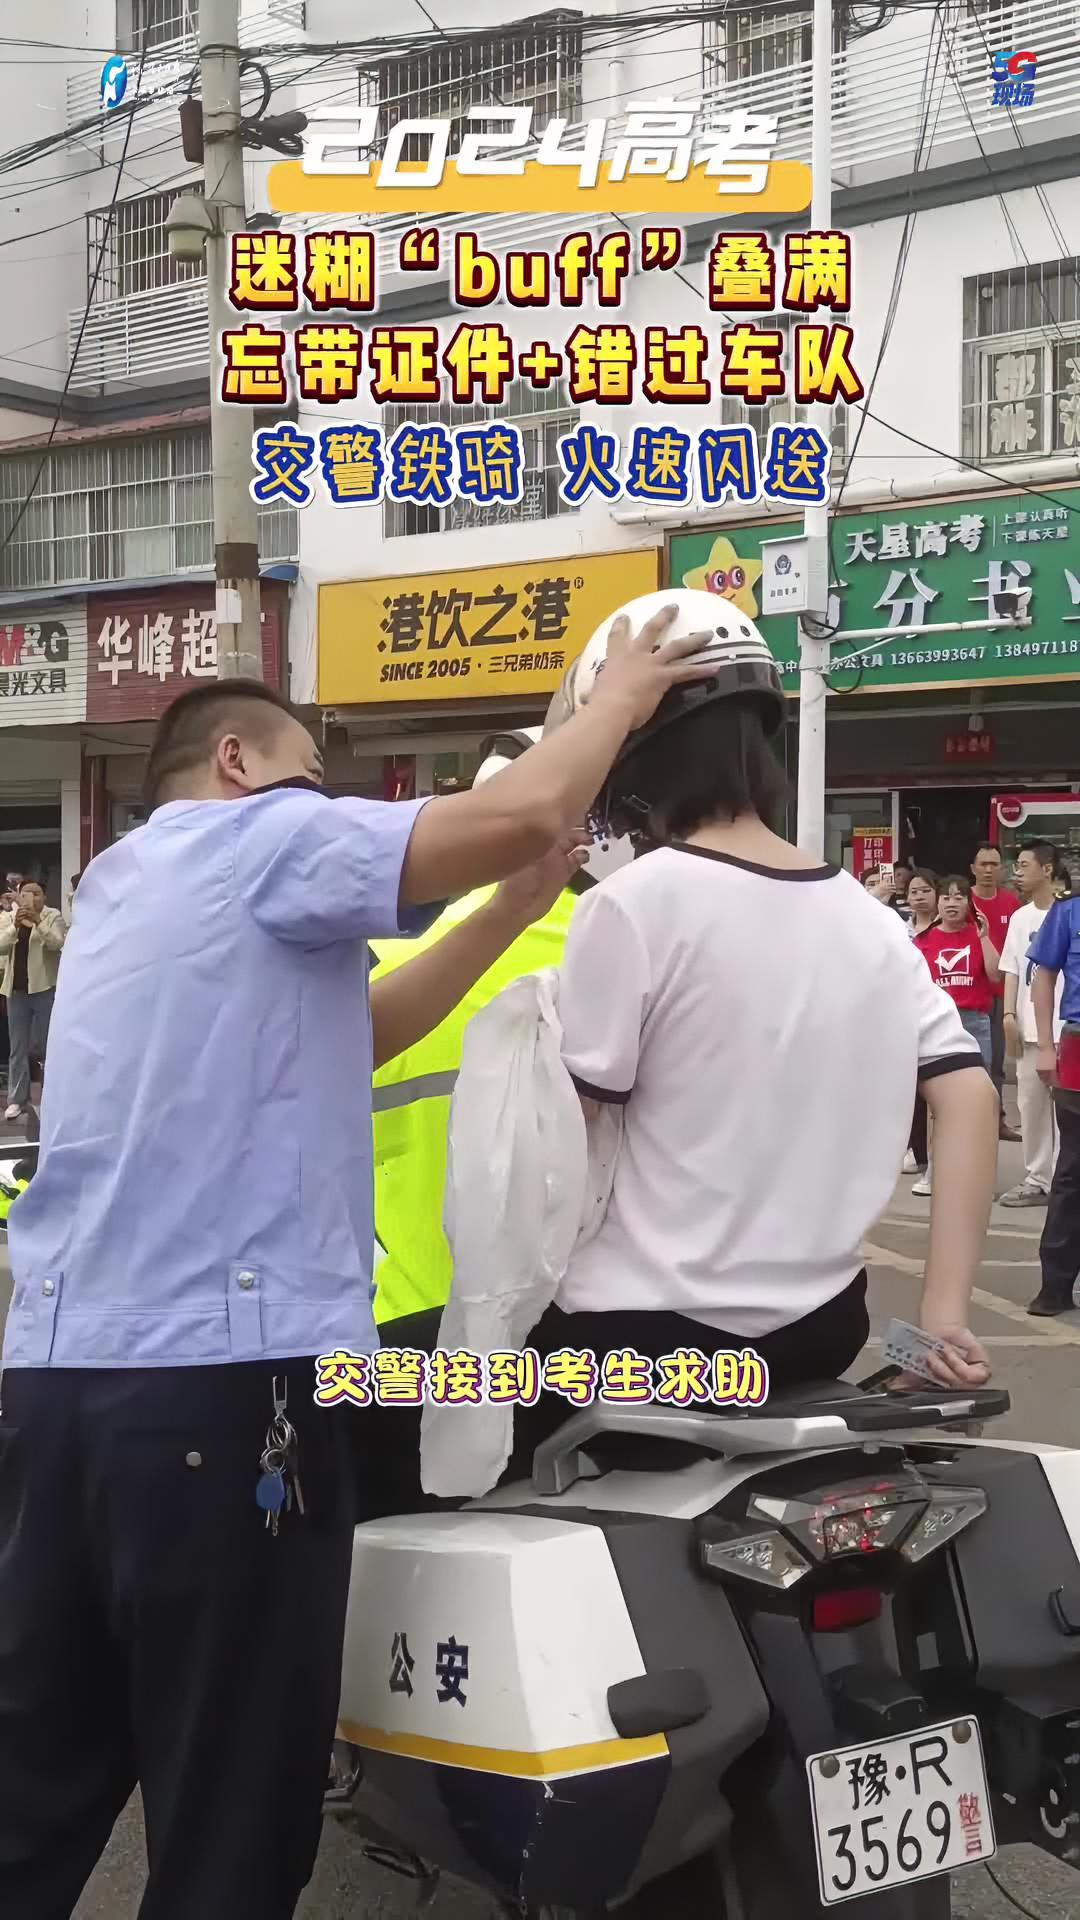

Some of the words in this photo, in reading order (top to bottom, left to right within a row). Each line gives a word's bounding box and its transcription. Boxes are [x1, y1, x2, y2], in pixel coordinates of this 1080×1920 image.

[843, 514, 985, 565] 天星高考
[377, 577, 571, 653] 港饮之港
[380, 662, 423, 682] SINCE
[427, 657, 472, 678] 2005
[488, 651, 565, 673] 三兄弟奶茶
[891, 646, 985, 665] 13663993647
[389, 1632, 469, 1708] 公安
[828, 1801, 951, 1891] 3569
